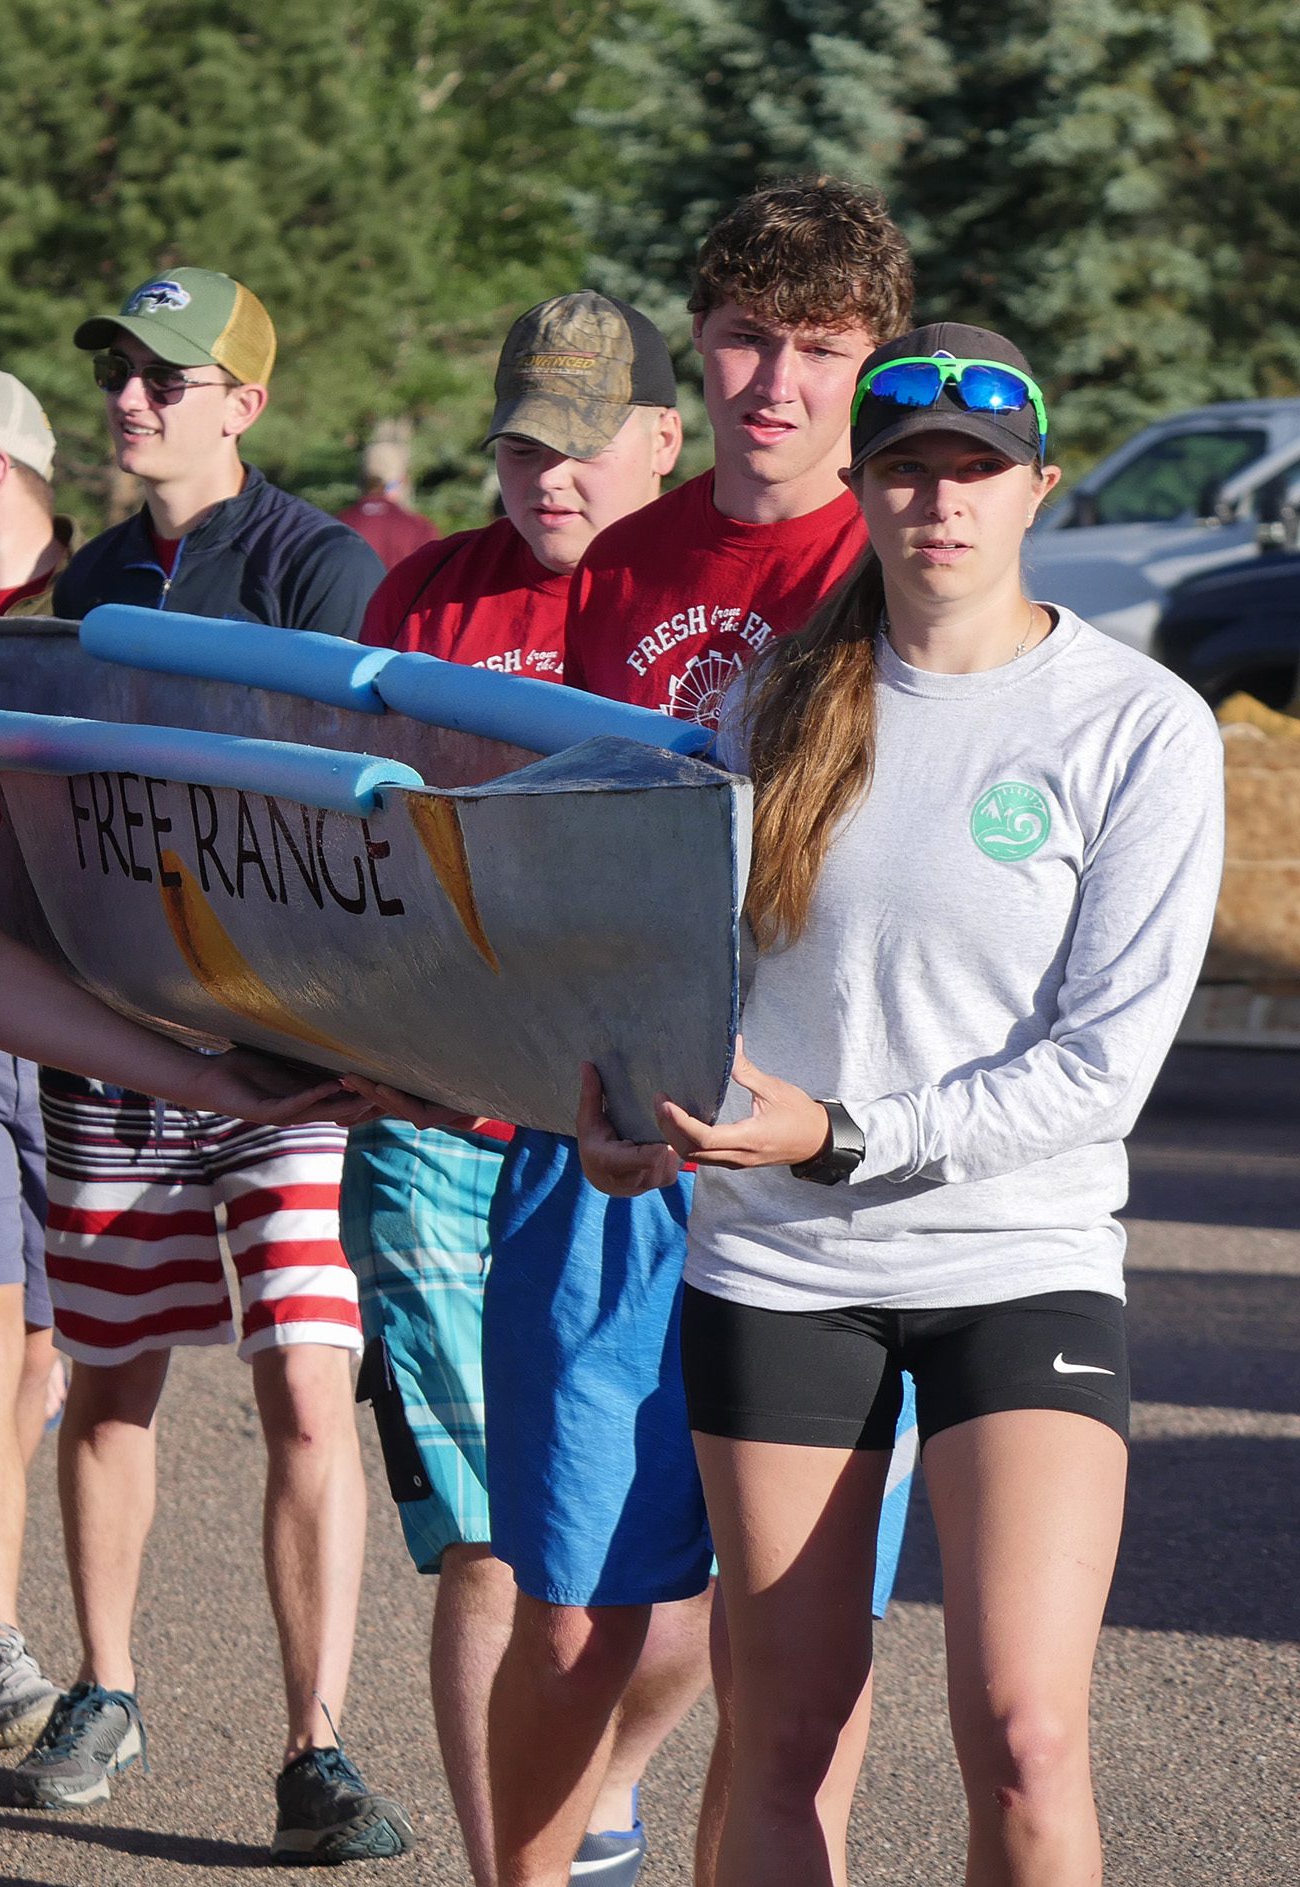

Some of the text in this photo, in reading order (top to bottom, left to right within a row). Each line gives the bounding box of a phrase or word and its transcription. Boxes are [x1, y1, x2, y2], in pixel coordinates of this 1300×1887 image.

[525, 648, 559, 672] from the
[626, 604, 779, 677] FRESH from the FA
[67, 771, 406, 917] FREE RANGE
